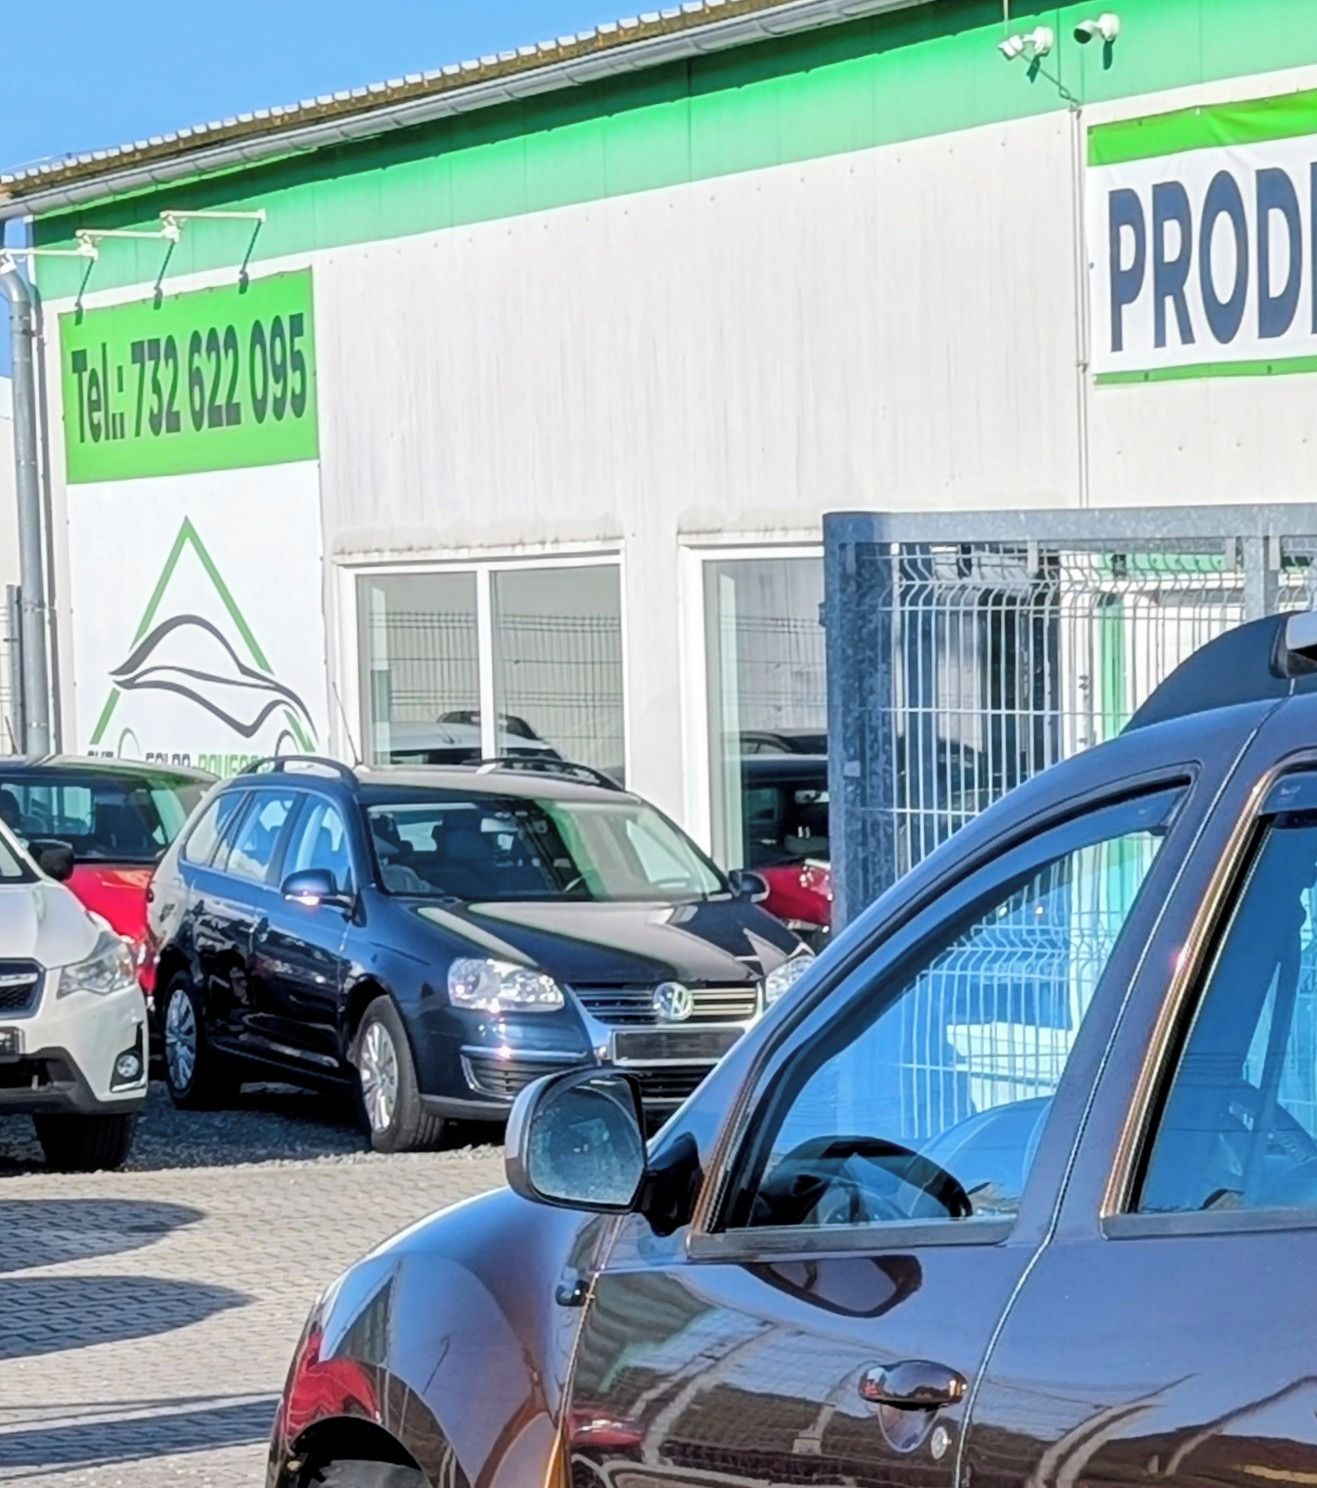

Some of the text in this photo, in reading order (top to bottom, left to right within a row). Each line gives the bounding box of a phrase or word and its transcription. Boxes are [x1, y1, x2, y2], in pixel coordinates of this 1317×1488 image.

[71, 312, 307, 443] Tel.: 732 622 095
